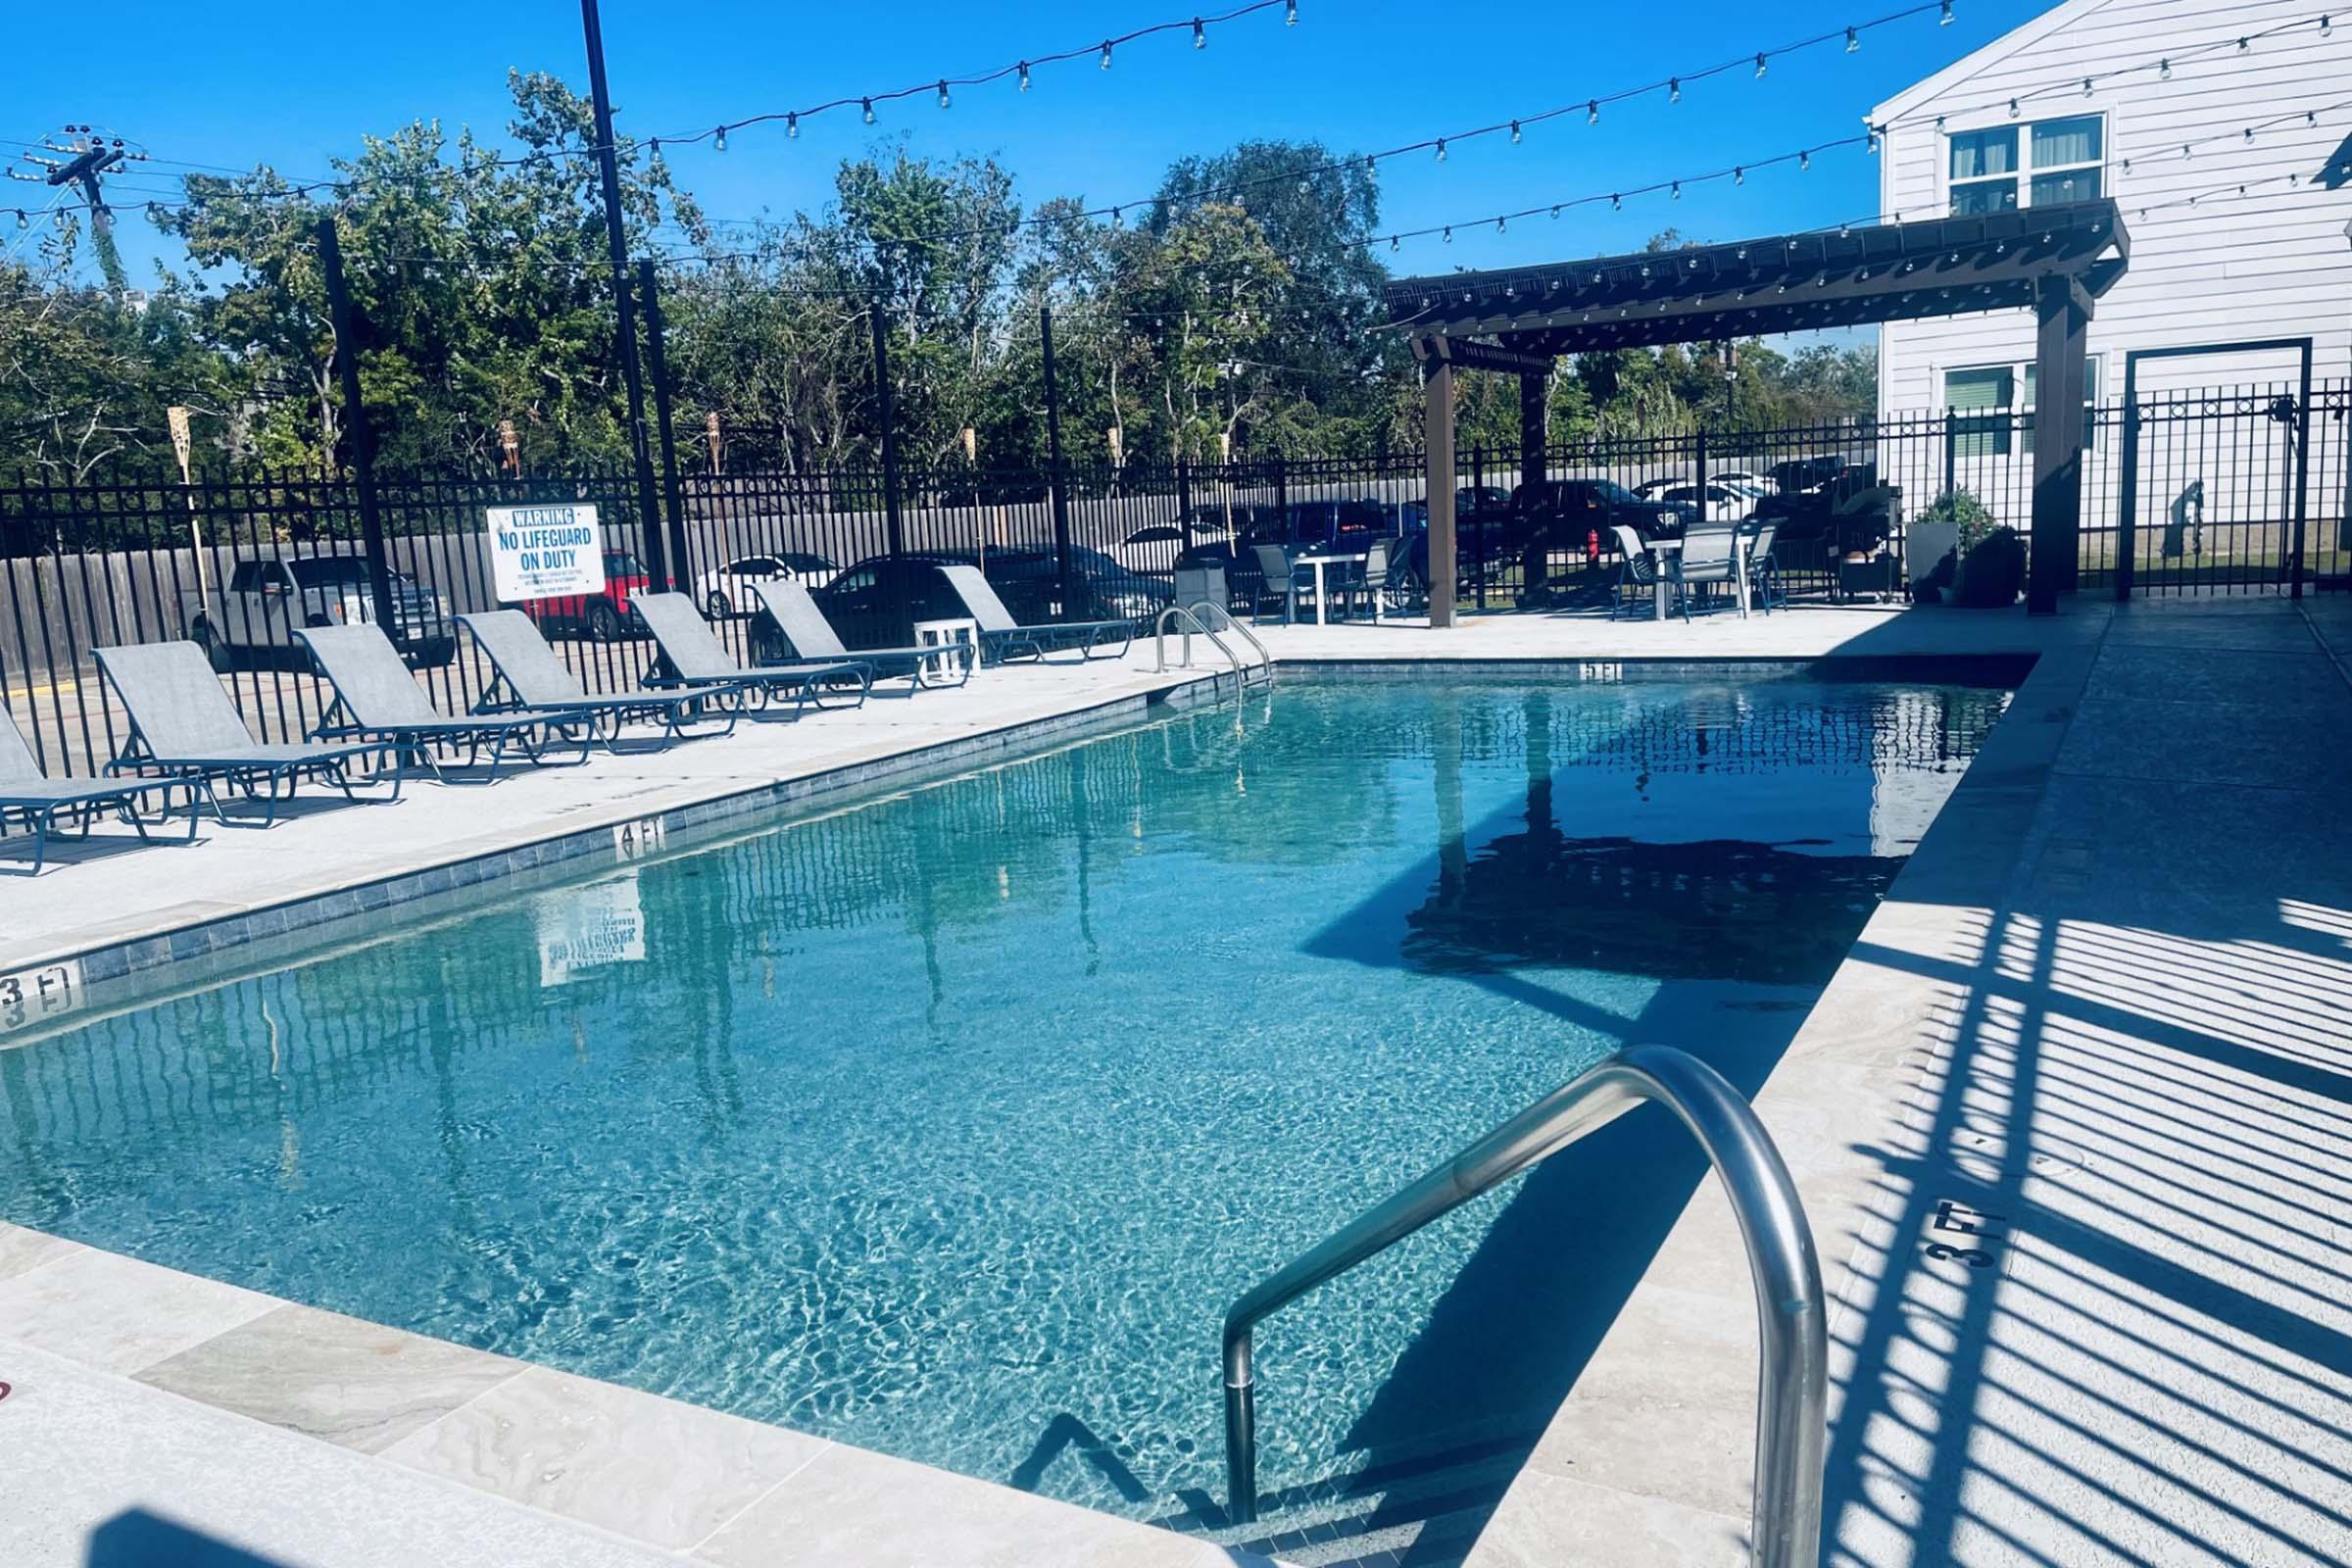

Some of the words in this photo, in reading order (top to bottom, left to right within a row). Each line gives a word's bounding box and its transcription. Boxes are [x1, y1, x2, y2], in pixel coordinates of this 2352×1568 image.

[514, 509, 573, 526] WARNING
[499, 532, 518, 550] NO
[522, 527, 592, 549] LIFEGUARD
[521, 553, 540, 570] ON
[544, 550, 576, 568] DUTY
[621, 824, 634, 842] 4
[642, 819, 660, 838] FT
[0, 978, 23, 1004] 3
[37, 967, 70, 995] FT
[1934, 1201, 2006, 1240] FT
[1926, 1244, 1995, 1267] 3
